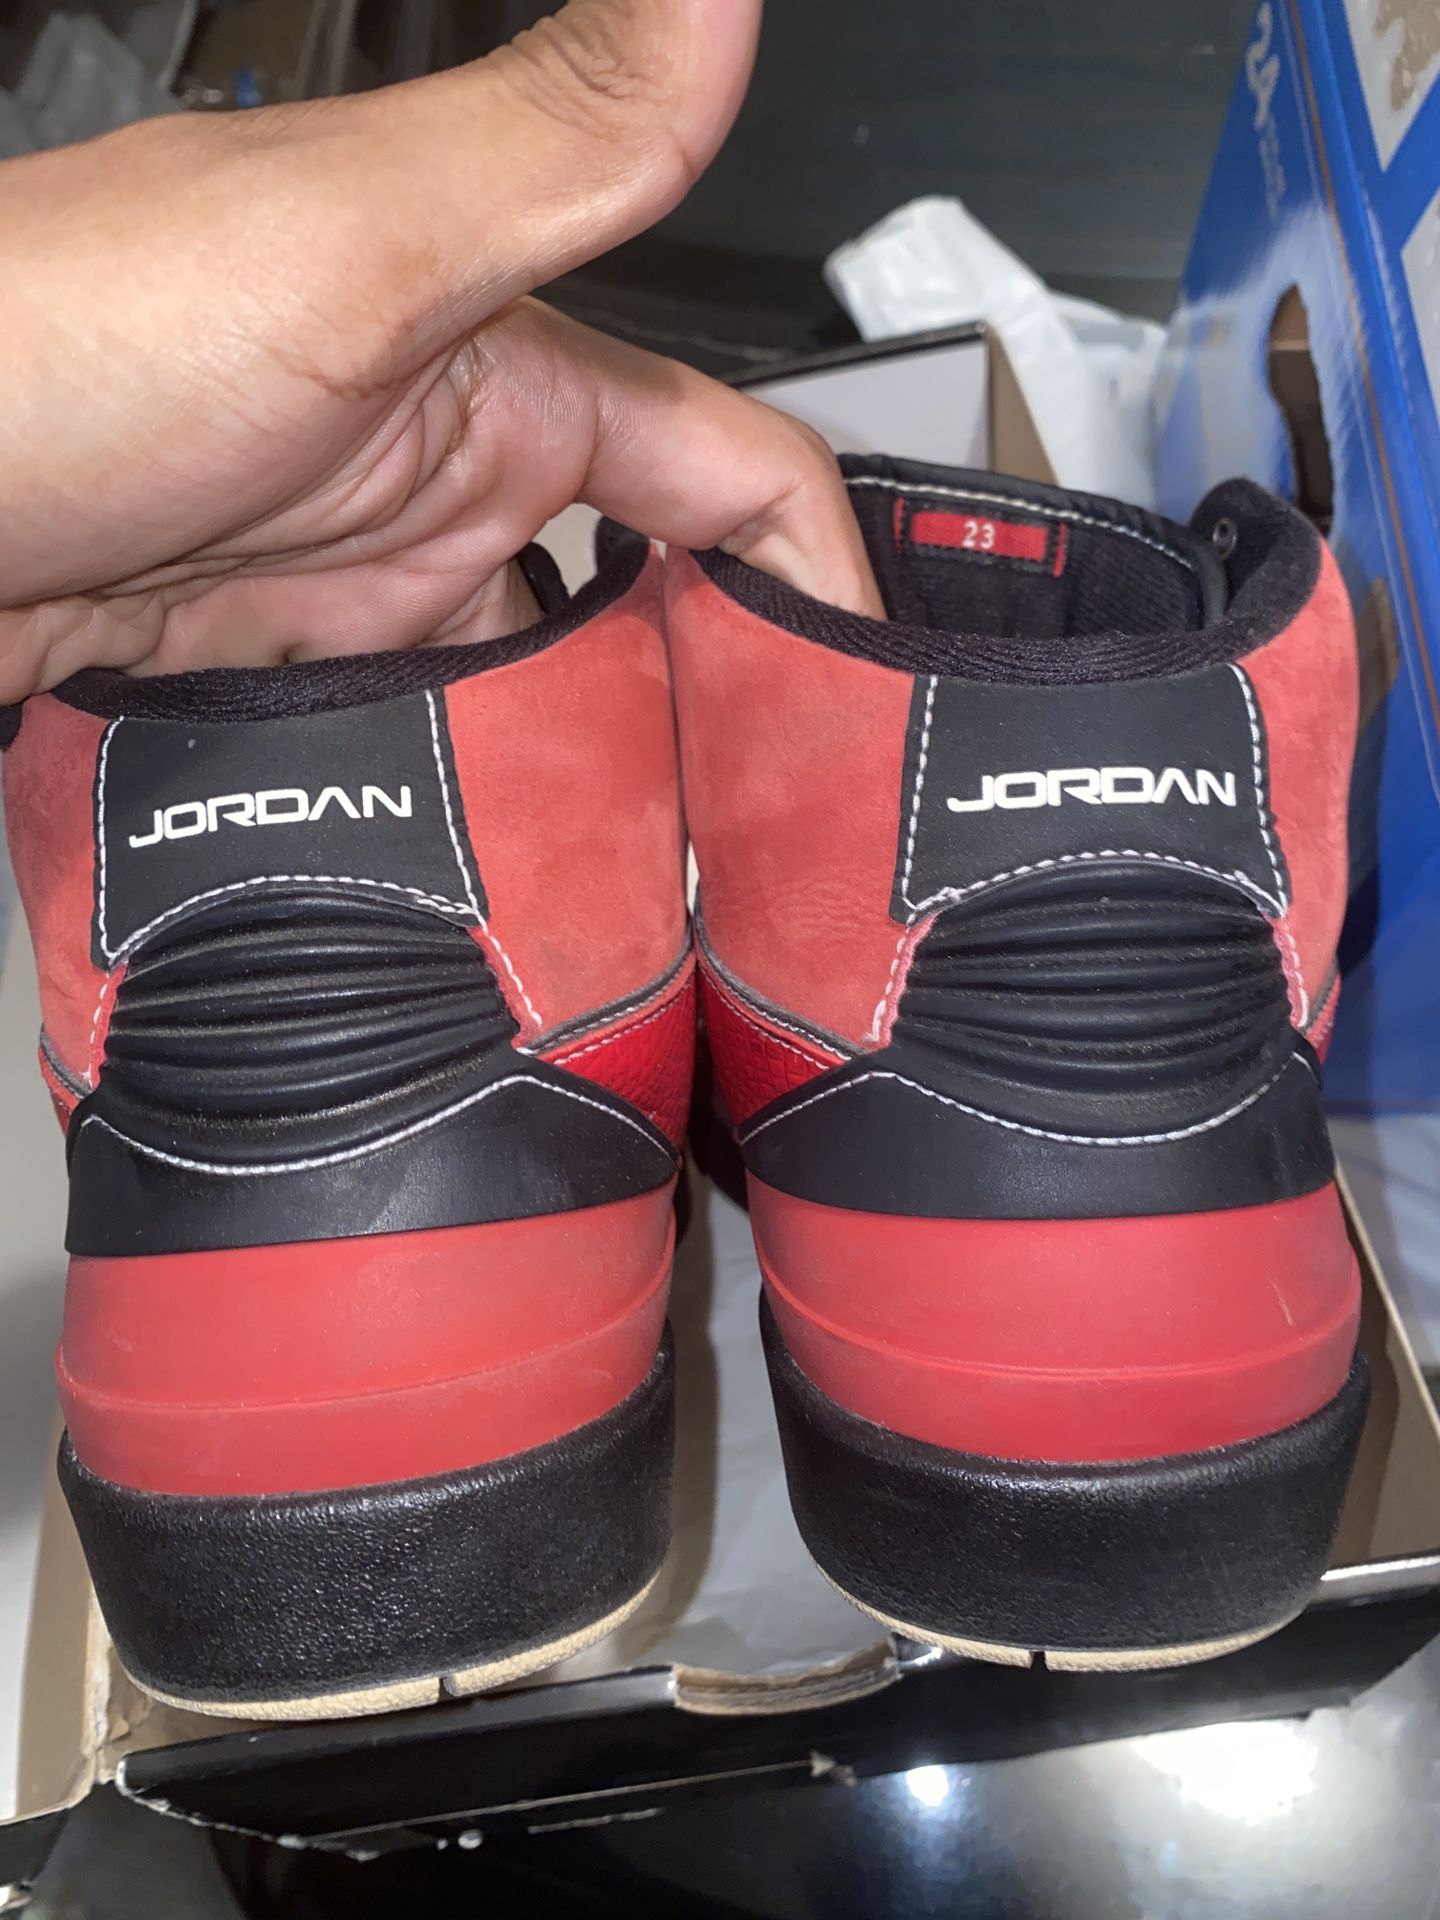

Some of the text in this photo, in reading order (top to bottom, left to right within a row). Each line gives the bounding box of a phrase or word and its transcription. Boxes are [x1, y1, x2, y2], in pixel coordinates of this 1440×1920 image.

[961, 519, 996, 550] 23
[946, 766, 1238, 813] JORDAN
[128, 785, 413, 849] JORDAN
